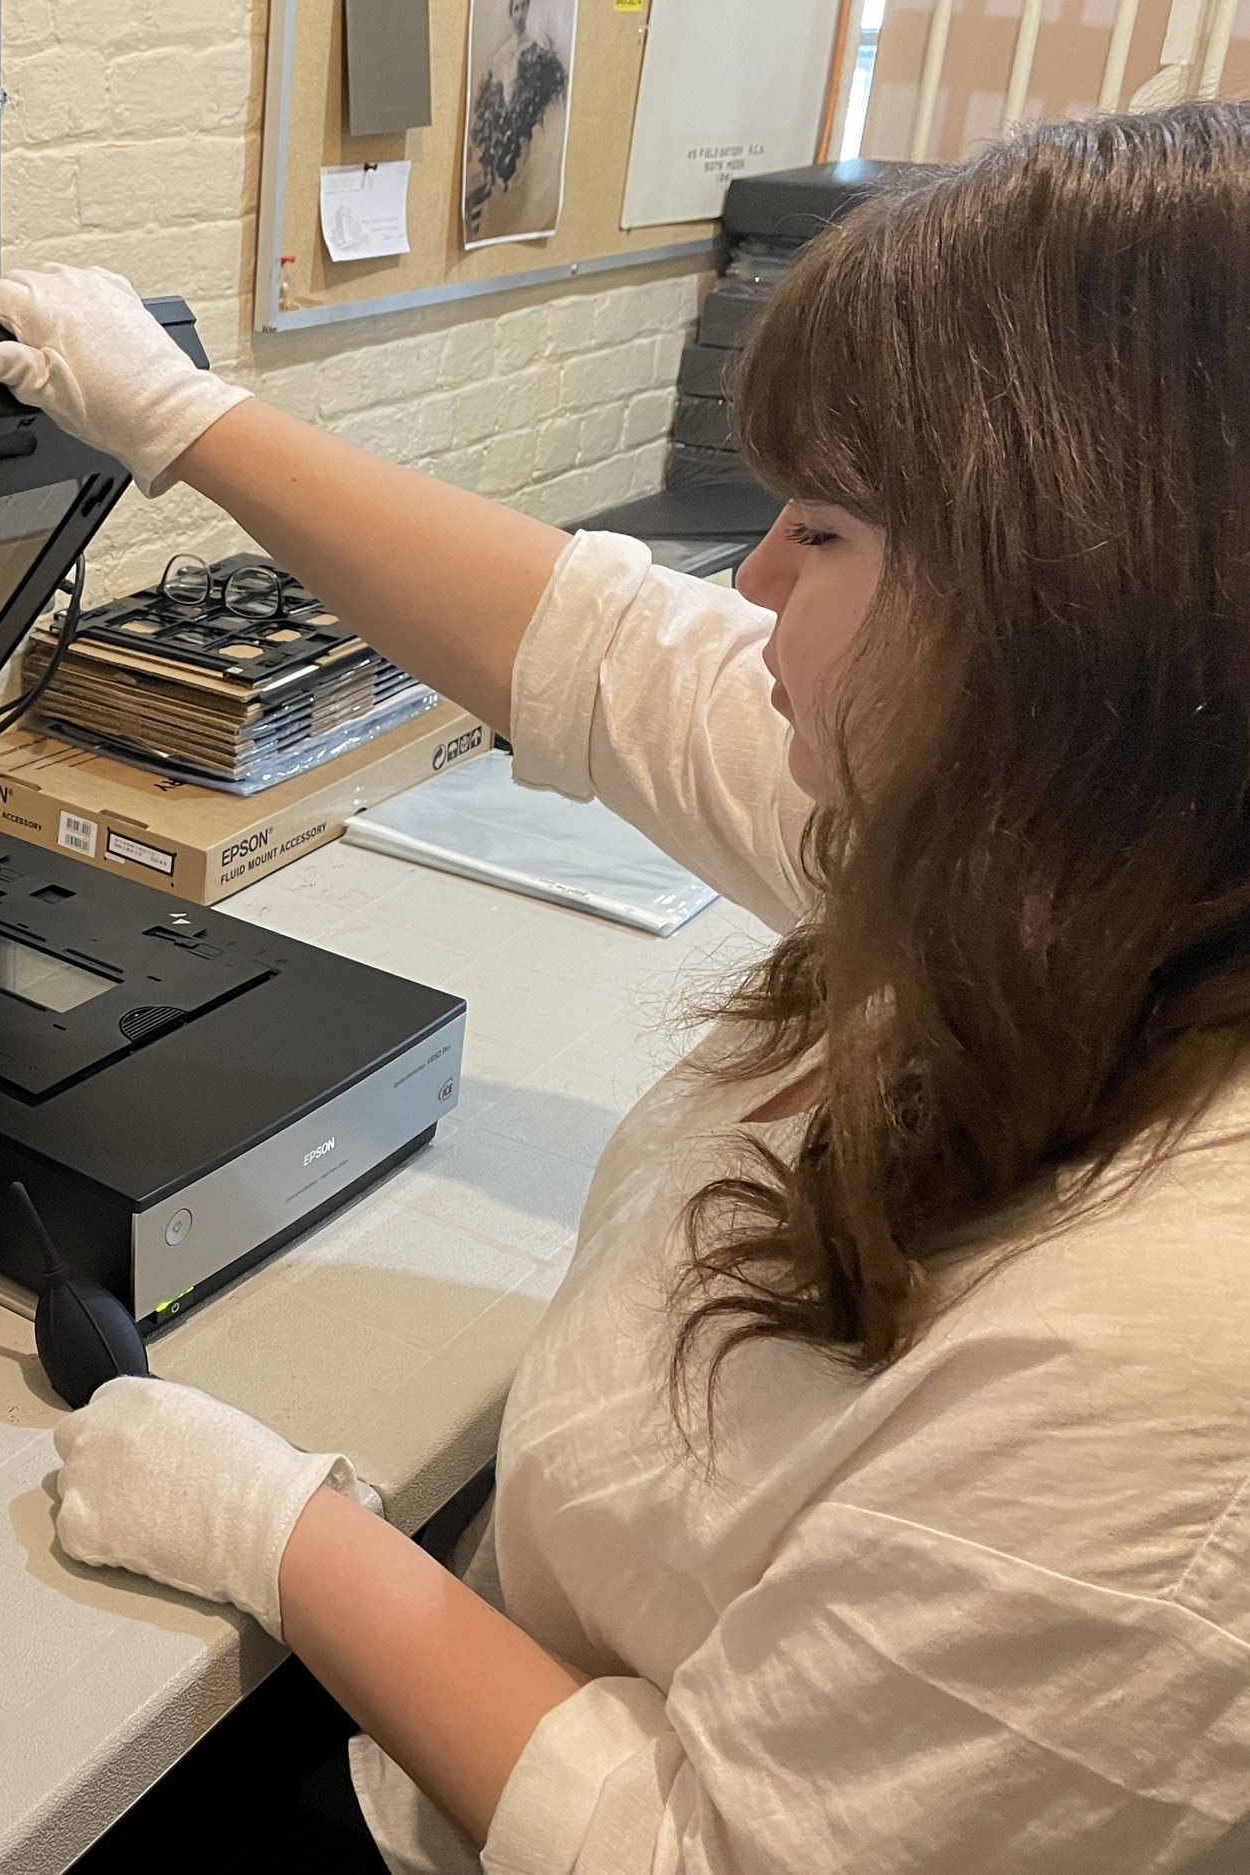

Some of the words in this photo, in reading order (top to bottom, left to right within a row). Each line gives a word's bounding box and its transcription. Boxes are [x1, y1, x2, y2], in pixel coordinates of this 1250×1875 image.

[2, 812, 42, 832] ACCESSORY
[220, 863, 246, 885] FLUID
[248, 847, 278, 870] MOUNT
[279, 822, 328, 854] ACCESSORY
[221, 828, 269, 867] EPSON
[303, 1137, 335, 1167] EPSON
